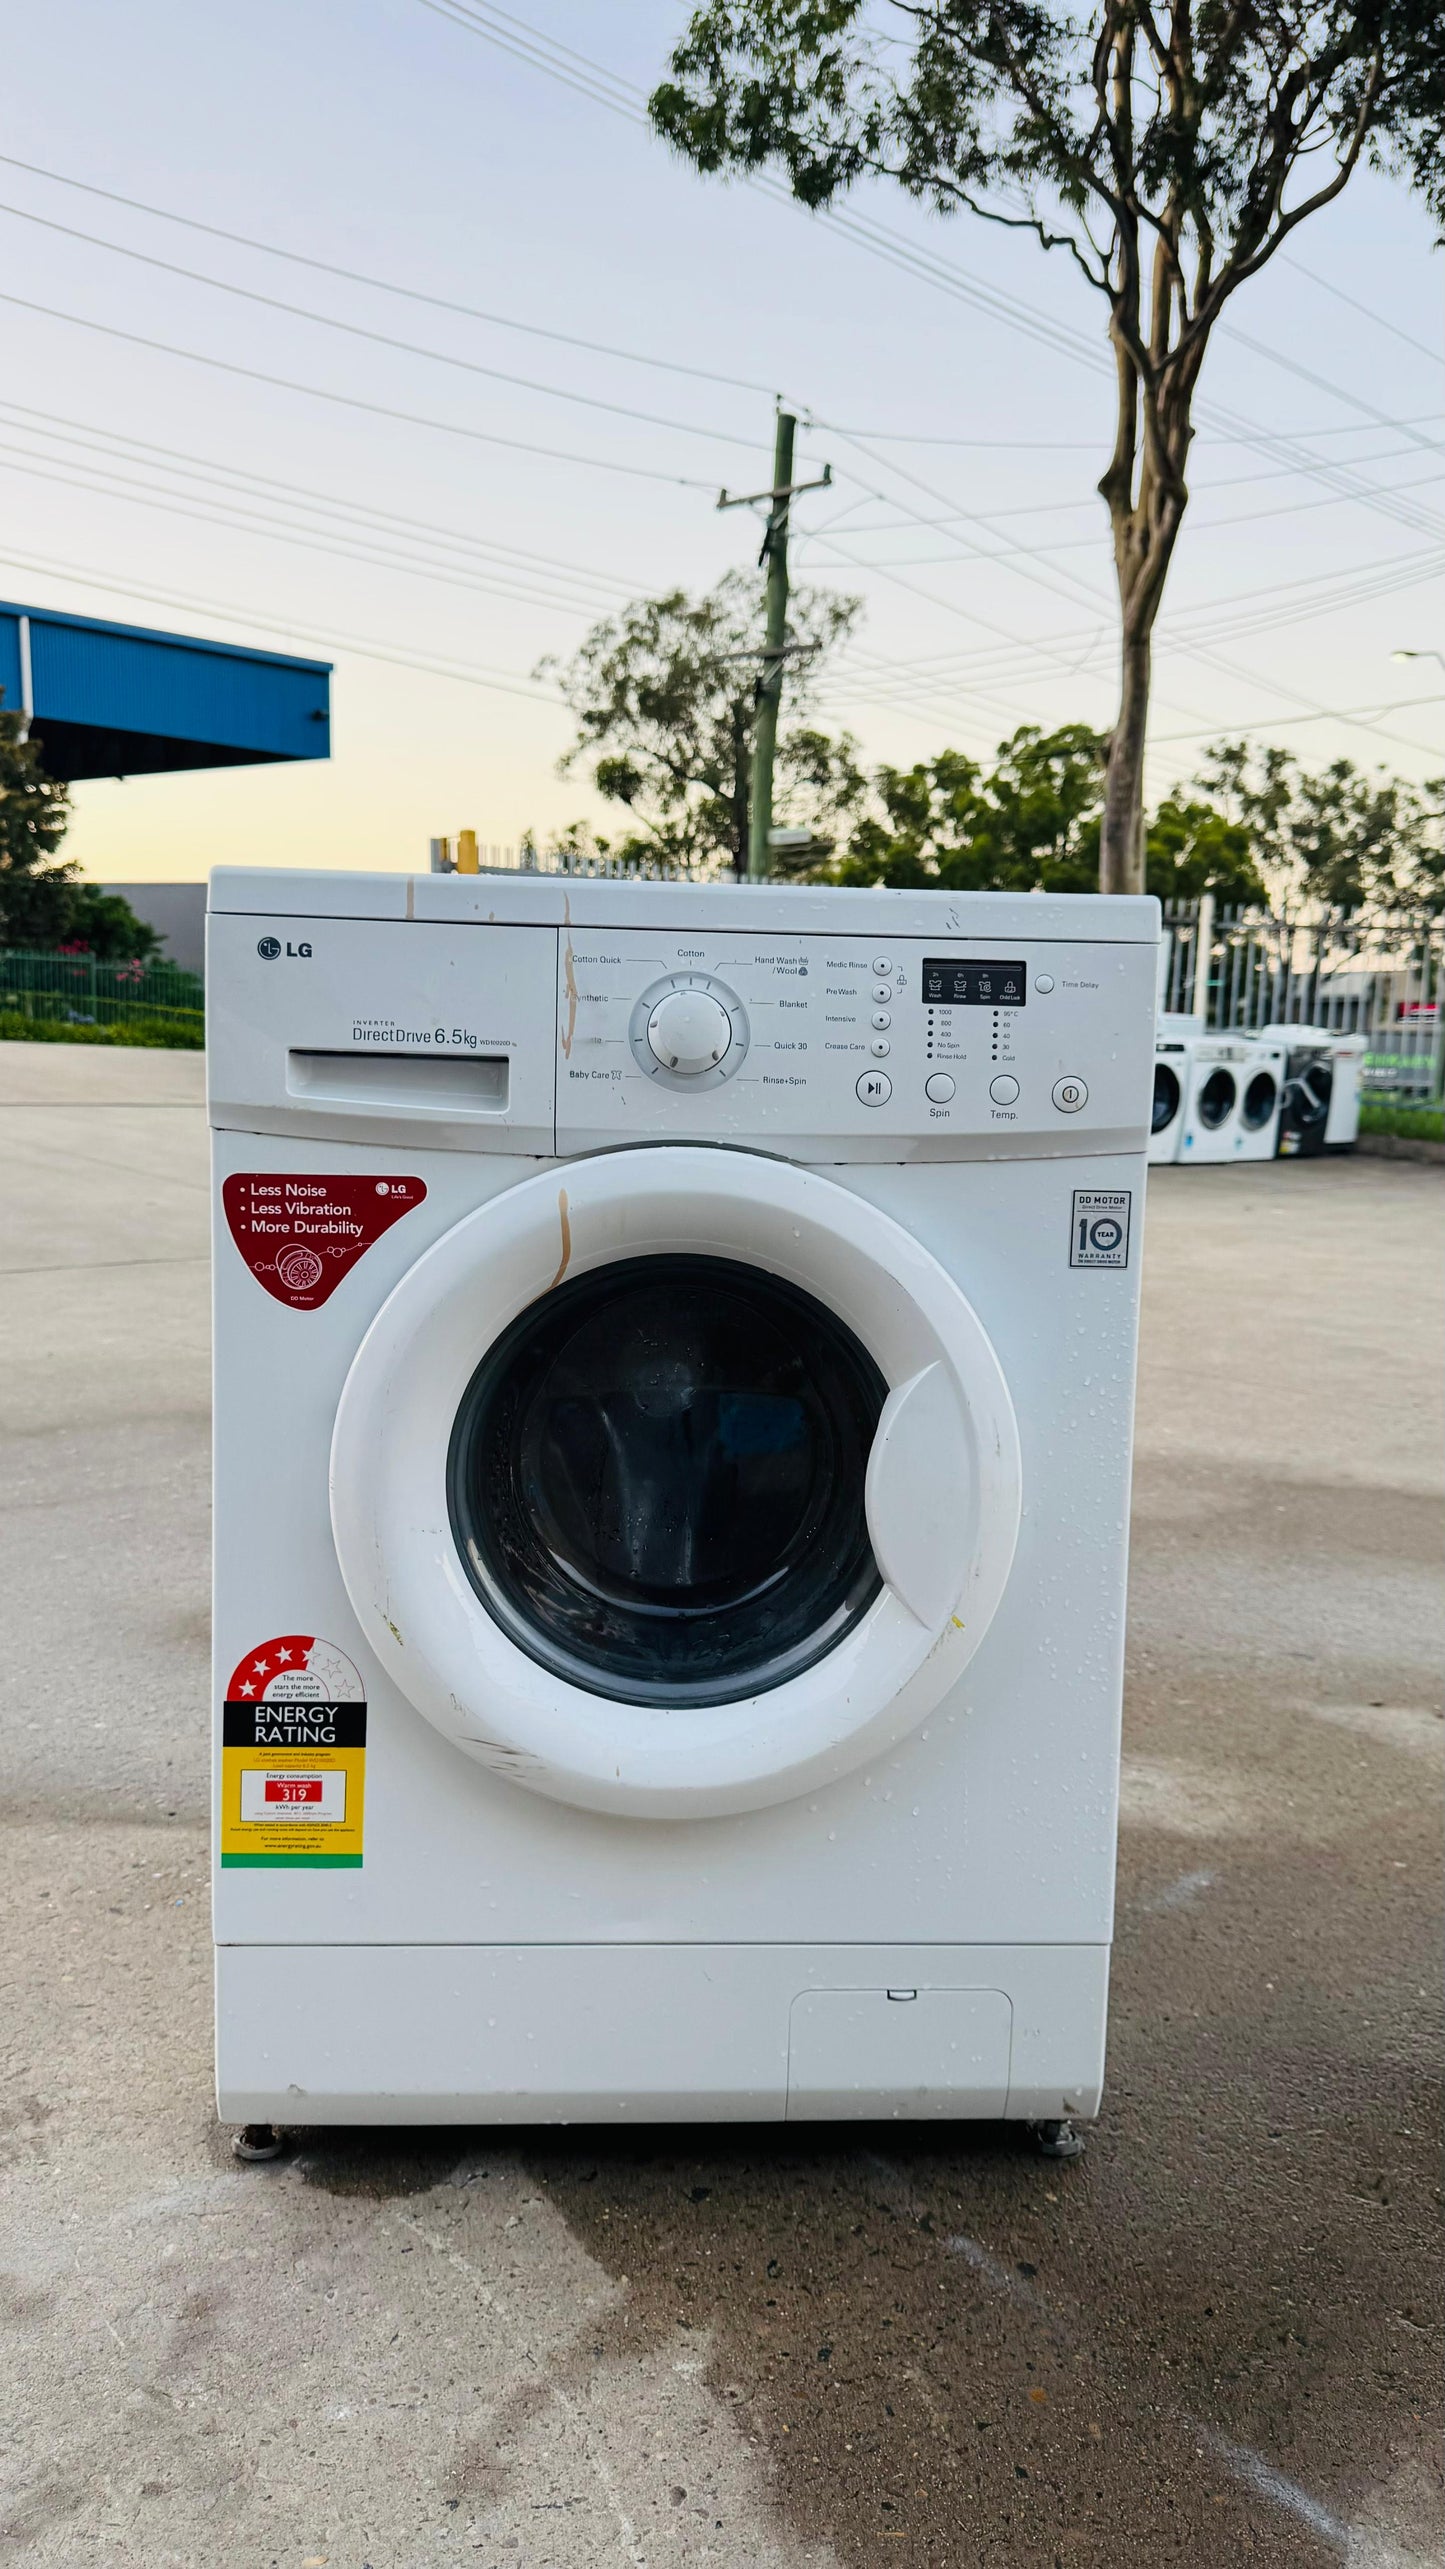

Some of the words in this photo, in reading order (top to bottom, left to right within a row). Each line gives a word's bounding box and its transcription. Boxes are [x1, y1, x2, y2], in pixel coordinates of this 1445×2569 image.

[286, 942, 312, 958] LG
[677, 948, 705, 958] Cotton
[572, 955, 598, 964] Cotton
[600, 956, 621, 964] Quick
[754, 956, 775, 965] Hand
[776, 956, 797, 965] Wash
[1062, 980, 1079, 988] Time
[1080, 981, 1099, 989] Delay
[779, 1000, 808, 1009] Blanket
[434, 1028, 477, 1048] 6.5kg
[774, 1042, 796, 1051] Quick
[569, 1070, 589, 1080] Baby
[591, 1071, 609, 1079] Care
[763, 1076, 807, 1086] Rinse+Spin
[929, 1108, 950, 1119] Spin
[990, 1110, 1018, 1120] Temp.
[251, 1183, 282, 1196] Less
[285, 1183, 327, 1197] Noise
[391, 1184, 406, 1194] LG
[1079, 1196, 1091, 1204] DD
[1094, 1196, 1126, 1205] MOTOR
[251, 1201, 282, 1215] Less
[285, 1201, 351, 1216] Vibration
[251, 1220, 290, 1234] More
[294, 1220, 363, 1237] Durability
[1079, 1218, 1123, 1251] 10
[255, 1706, 339, 1723] ENERGY
[255, 1726, 336, 1743] RATING
[266, 1772, 285, 1780] Energy
[282, 1788, 307, 1801] 319
